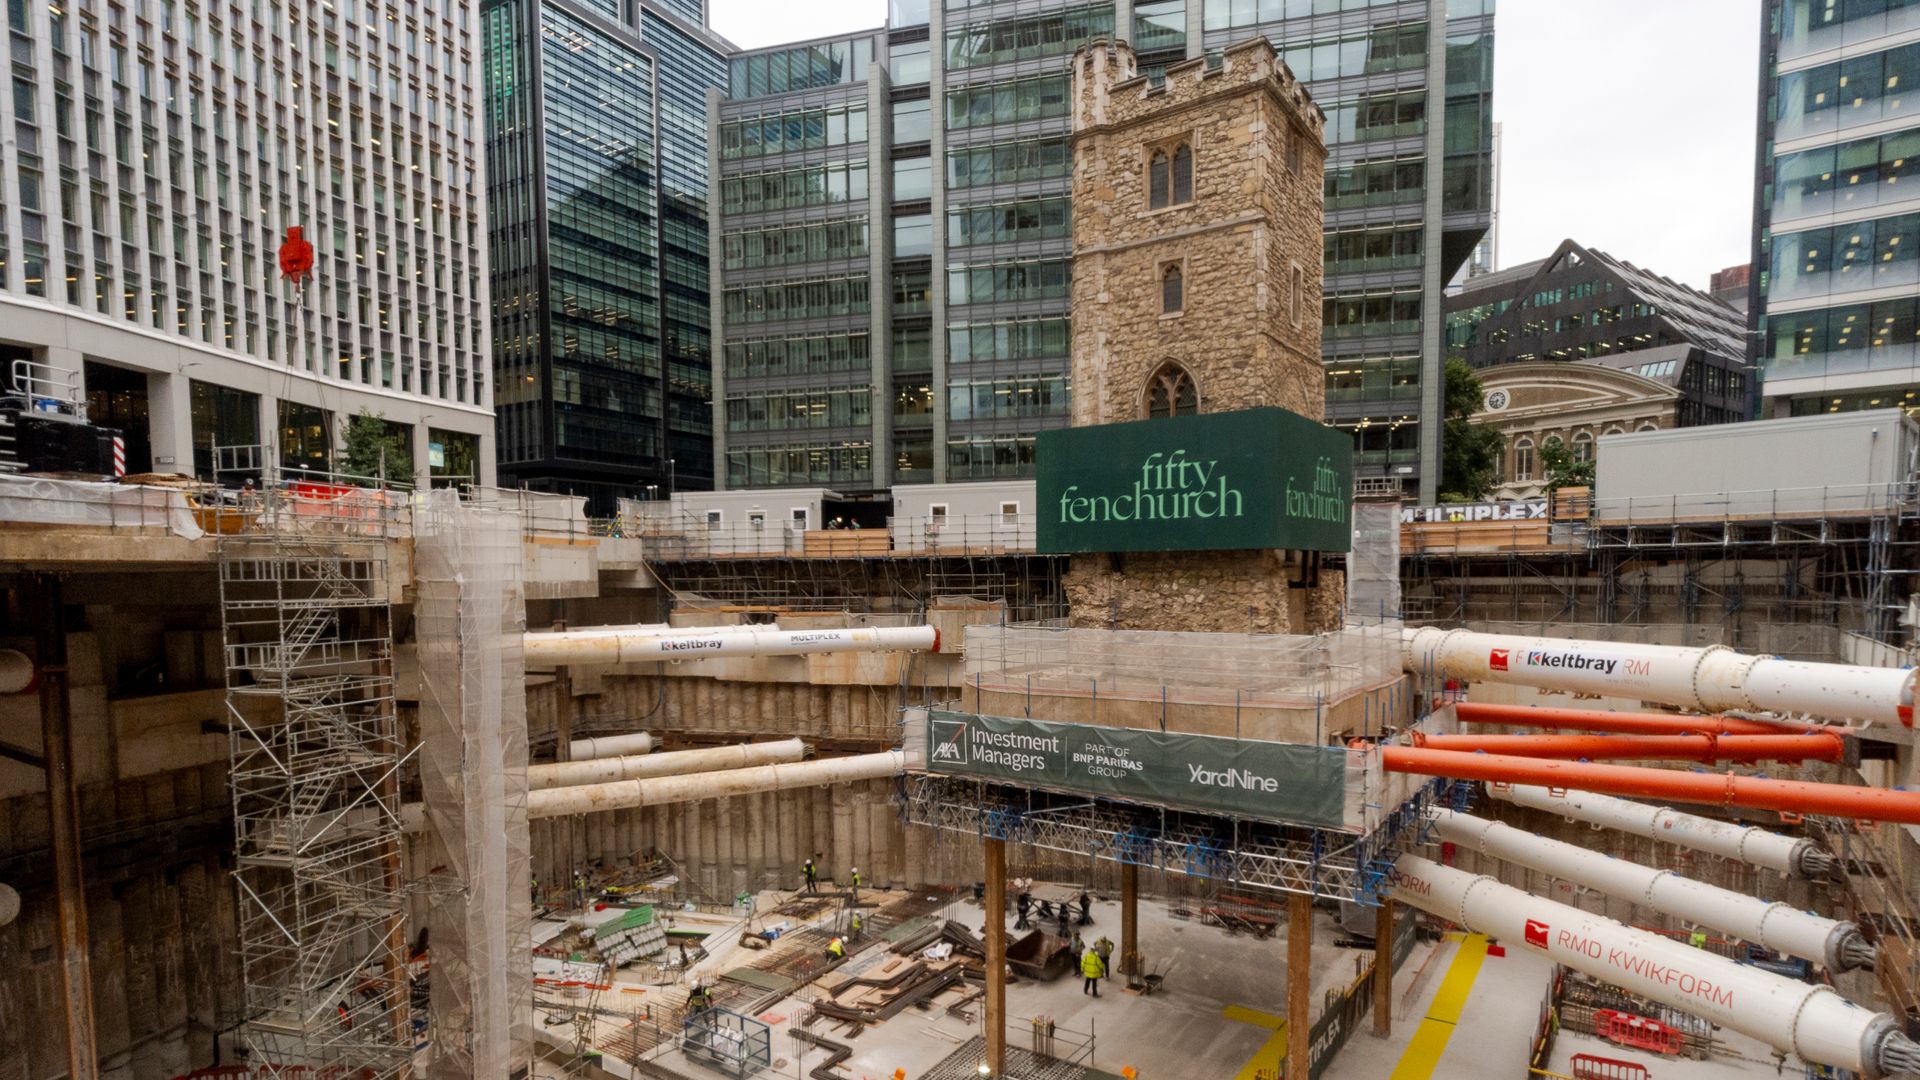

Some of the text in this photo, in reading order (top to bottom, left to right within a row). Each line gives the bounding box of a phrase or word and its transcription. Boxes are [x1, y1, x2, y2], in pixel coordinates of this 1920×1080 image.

[1142, 449, 1218, 497] fifty
[1060, 475, 1244, 523] fenchurch
[1286, 476, 1345, 523] fenchurch
[672, 639, 722, 650] keltbray
[791, 632, 841, 642] MULTIPLEX
[1541, 652, 1617, 675] keltbray
[932, 742, 961, 759] AXA
[972, 726, 1060, 753] Investment
[1085, 743, 1130, 757] PART OF
[972, 745, 1046, 772] Managers
[1073, 752, 1144, 771] BNP PARIBAS
[1087, 765, 1127, 779] GROUP
[1188, 763, 1279, 792] YardNine
[1558, 929, 1602, 959] RMD
[1608, 947, 1734, 1009] KWIKFORM
